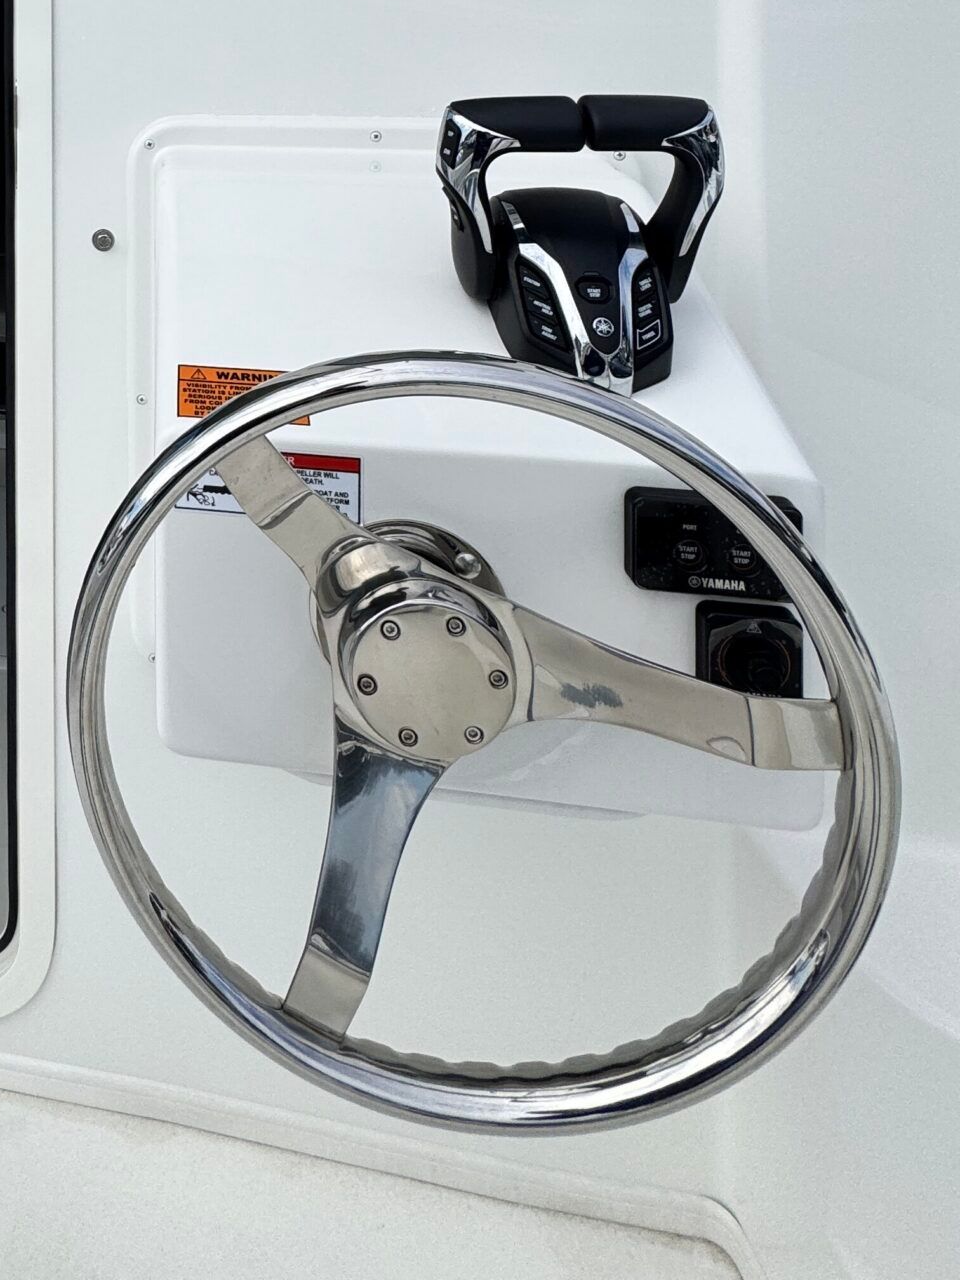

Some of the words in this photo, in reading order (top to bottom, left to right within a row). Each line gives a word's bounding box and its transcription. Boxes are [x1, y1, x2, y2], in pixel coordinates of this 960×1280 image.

[186, 382, 227, 390] VISIBILITY
[682, 523, 697, 531] PORT
[679, 545, 698, 553] START
[732, 549, 751, 557] START
[701, 577, 746, 592] YAMAHA
